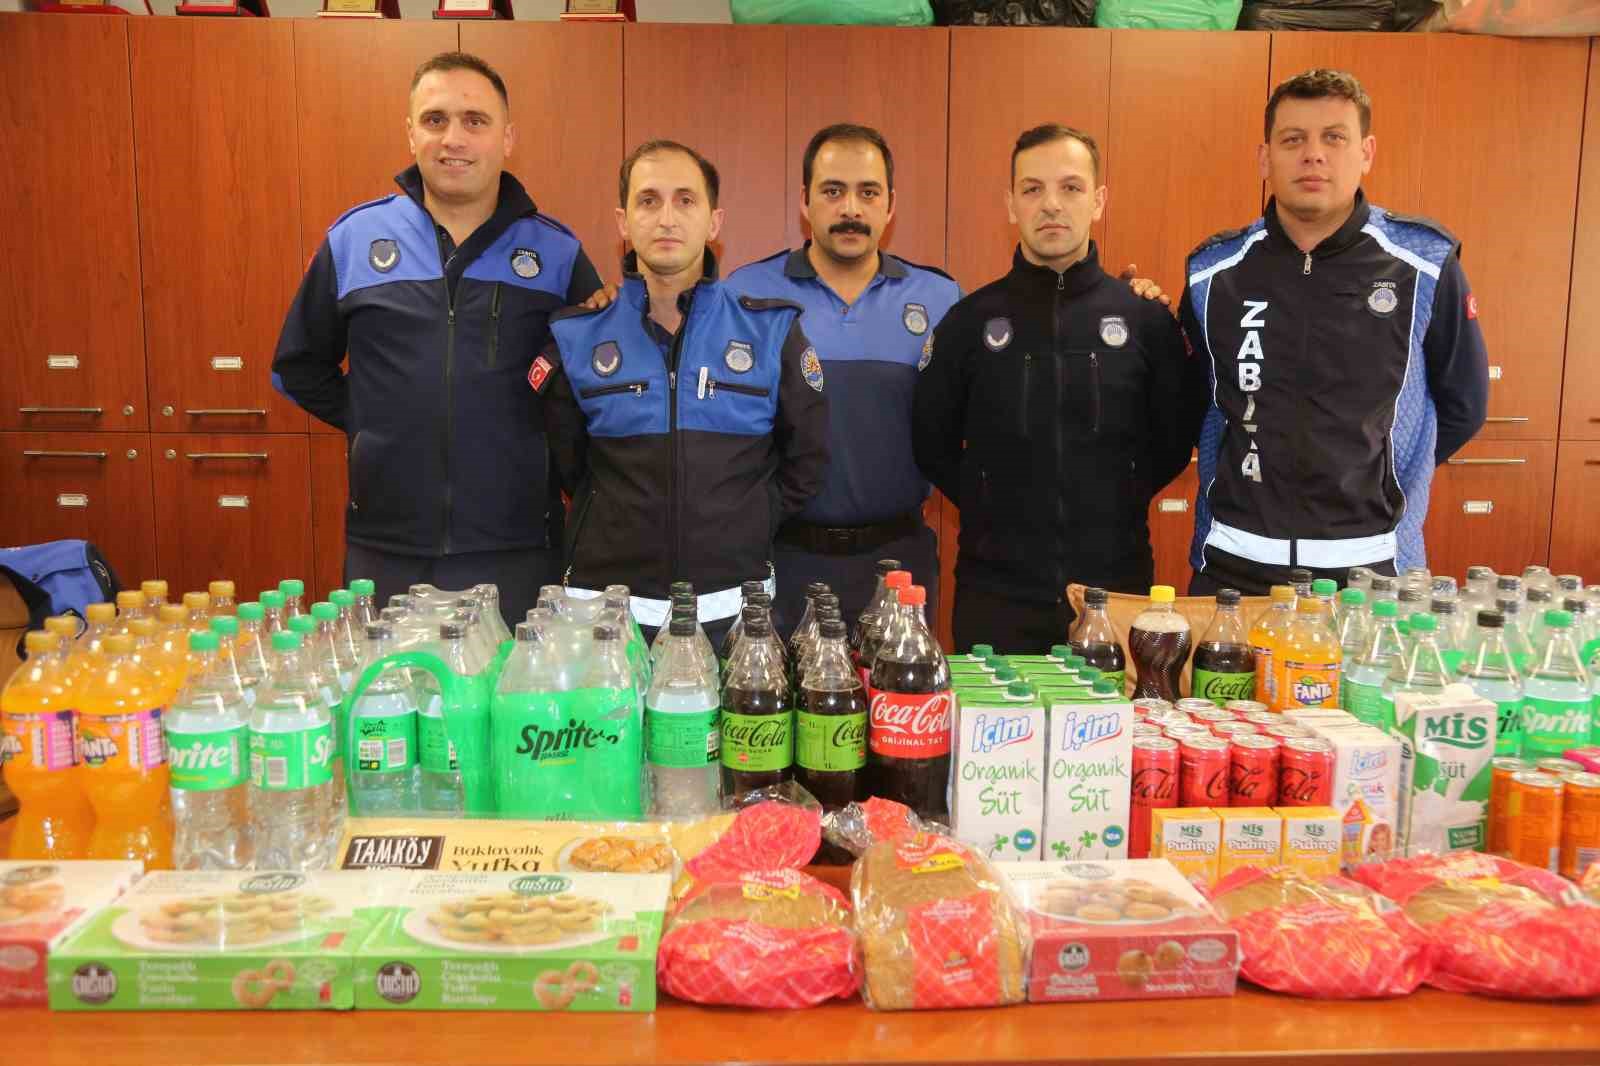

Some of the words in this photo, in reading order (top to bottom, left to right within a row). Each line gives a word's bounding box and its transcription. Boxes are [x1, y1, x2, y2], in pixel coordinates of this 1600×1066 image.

[962, 758, 1040, 784] Organik
[1053, 755, 1129, 782] Organik
[979, 786, 1022, 816] Süt
[1068, 784, 1112, 813] Süt
[352, 837, 432, 865] TAMKÖY
